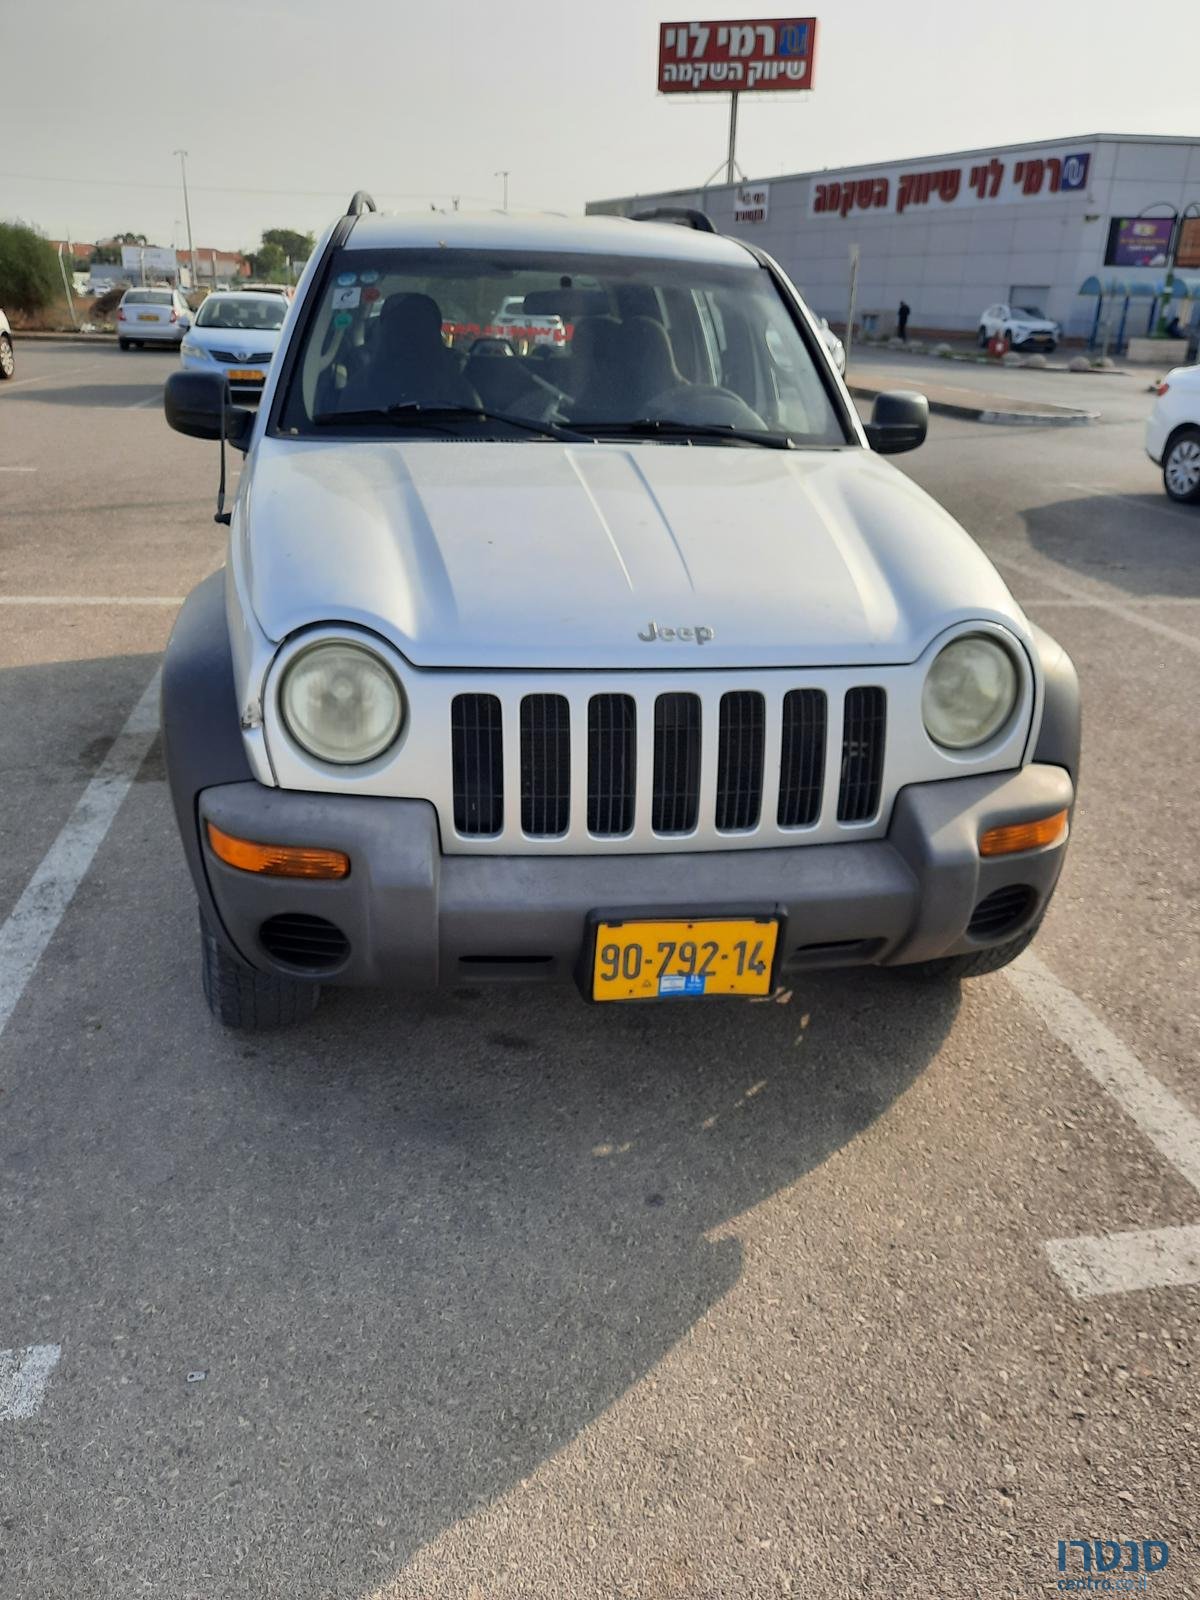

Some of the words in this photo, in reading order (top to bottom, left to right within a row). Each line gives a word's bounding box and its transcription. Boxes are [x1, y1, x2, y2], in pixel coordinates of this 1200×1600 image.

[664, 22, 711, 58] לוי
[717, 25, 776, 57] רמי
[663, 61, 744, 88] השקמה
[747, 60, 807, 87] שיווק
[896, 169, 961, 214] שיווק
[969, 158, 1004, 199] לוי
[1013, 158, 1061, 195] רמי
[813, 178, 890, 218] השקמה
[637, 619, 715, 645] Jeep
[600, 940, 767, 982] 90-792-14
